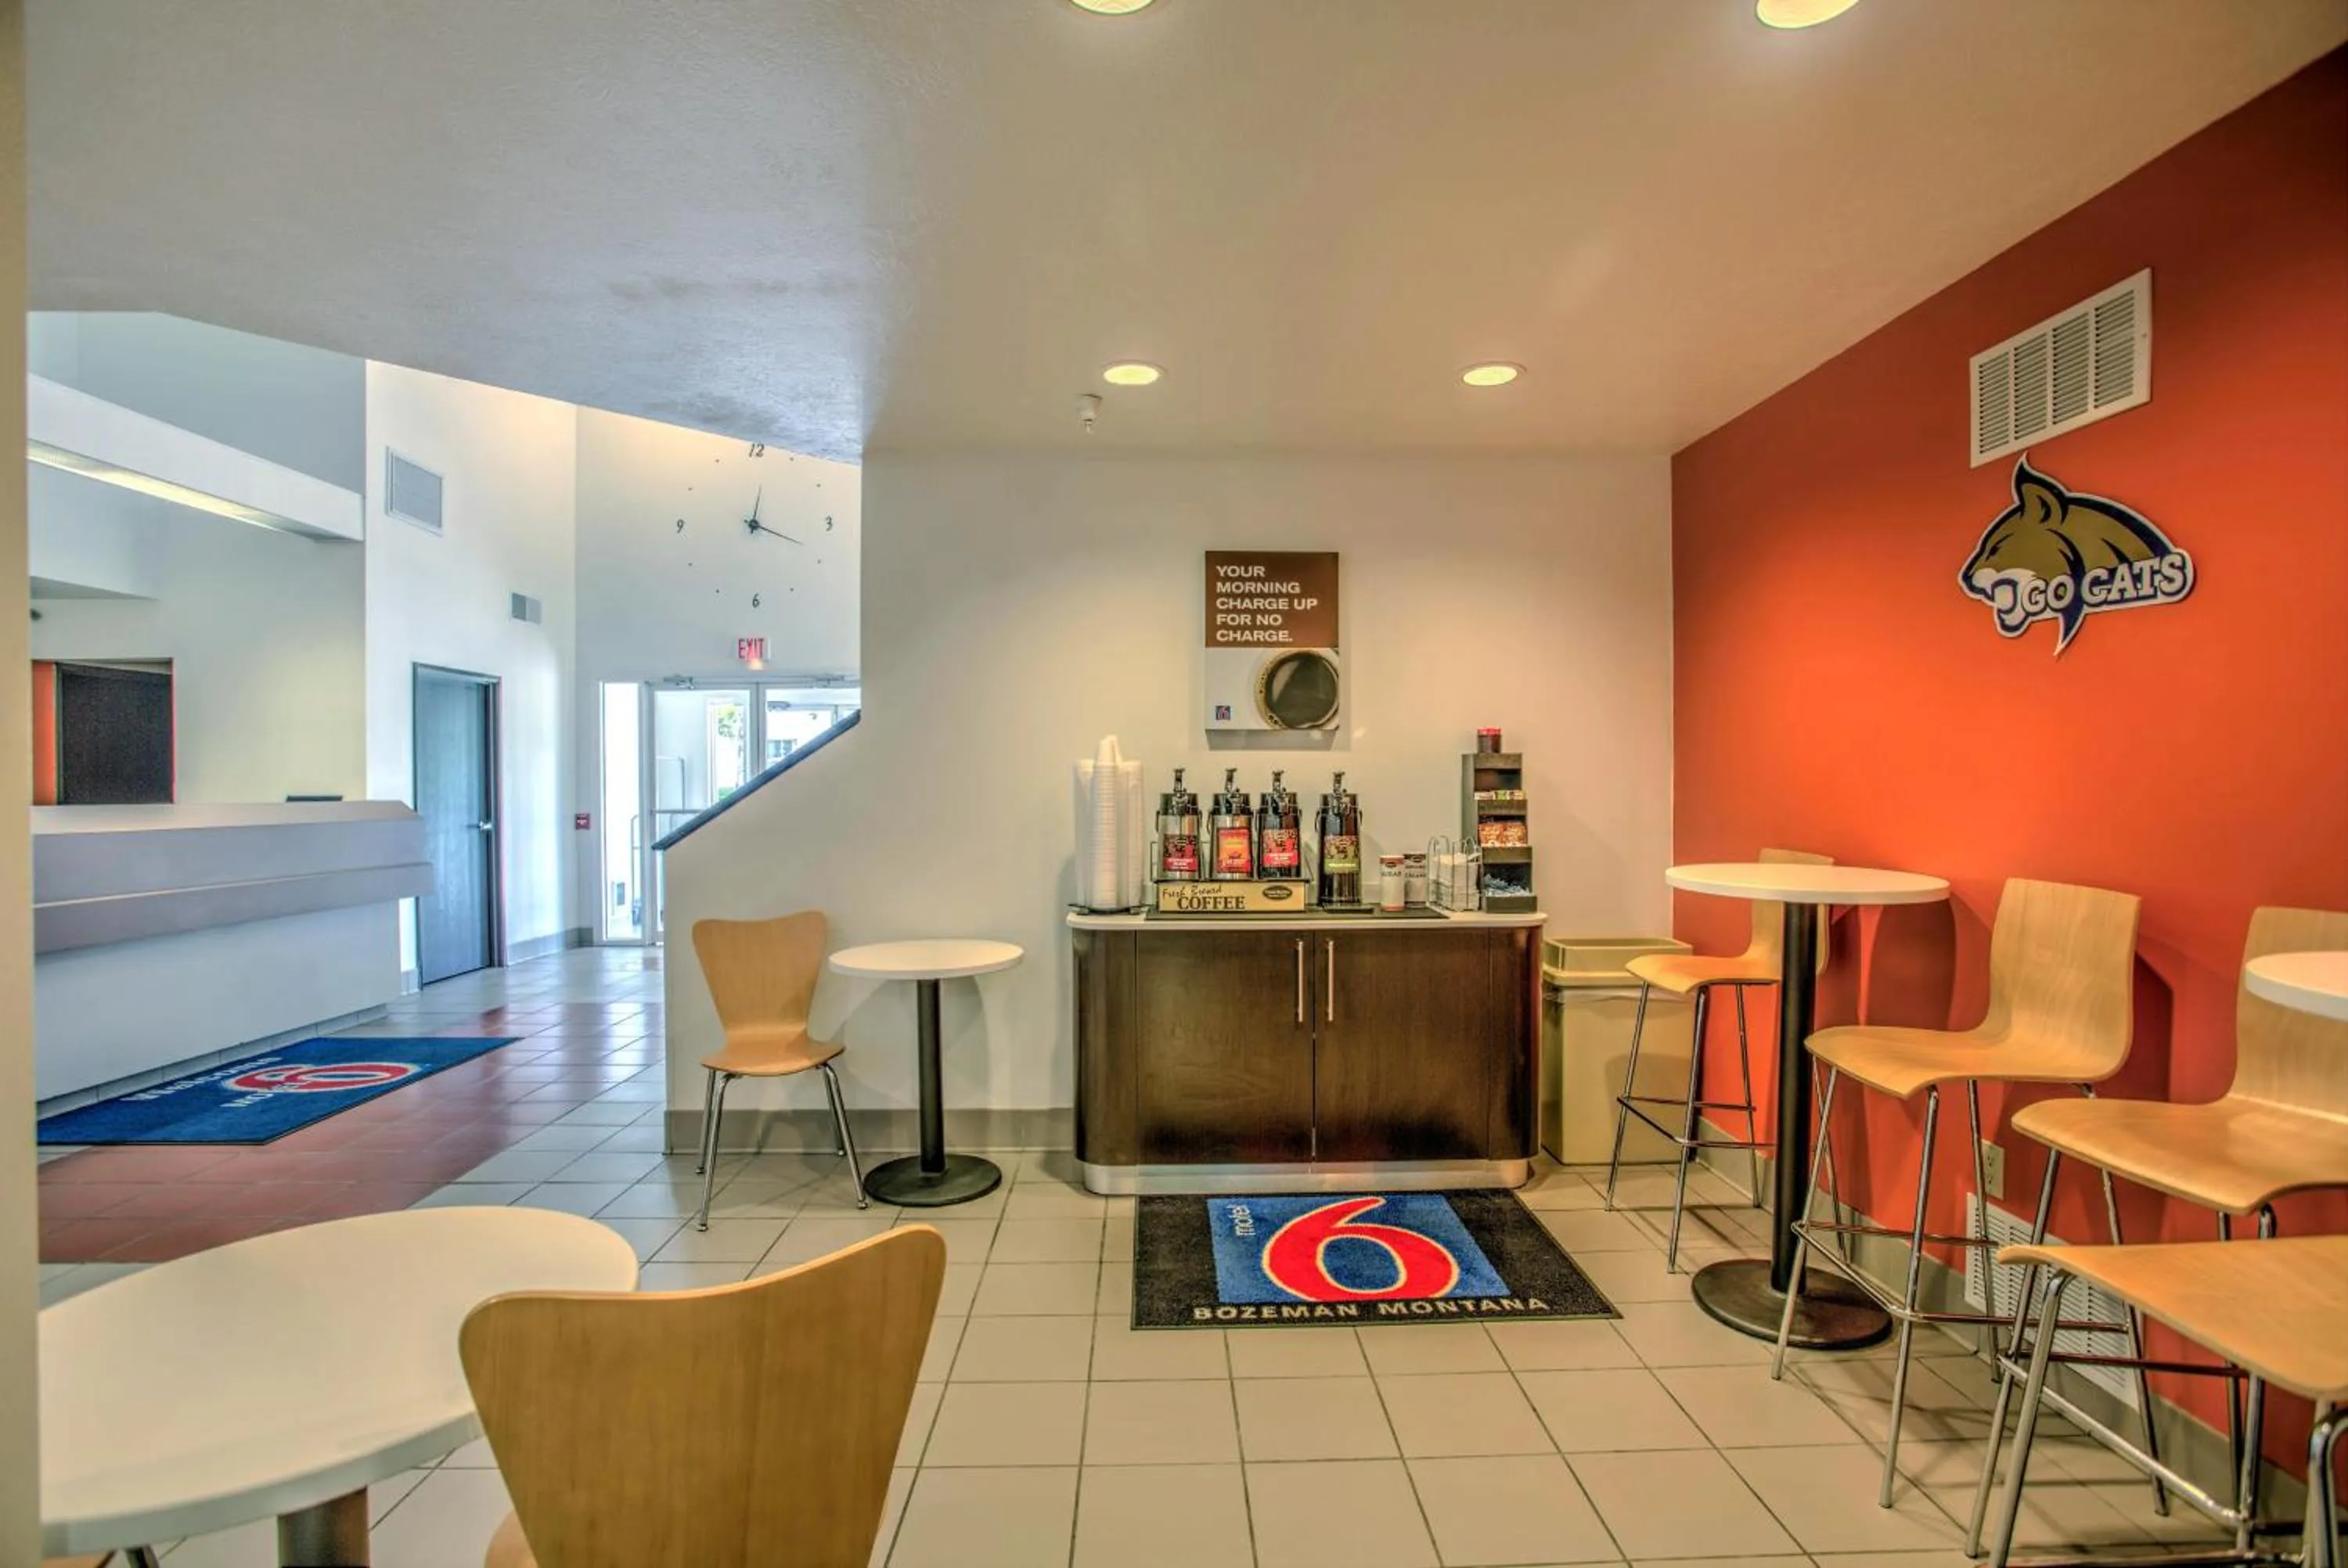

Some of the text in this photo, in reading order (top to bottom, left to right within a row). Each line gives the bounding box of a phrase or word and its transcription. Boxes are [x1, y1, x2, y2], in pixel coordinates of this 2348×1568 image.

[748, 443, 765, 458] 12
[676, 519, 685, 534] 9
[825, 515, 833, 532] 3
[1216, 565, 1266, 577] YOUR
[1216, 582, 1301, 594] MORNING
[2022, 553, 2184, 613] GO CATS
[751, 593, 760, 608] 6
[1216, 598, 1318, 610] CHARGE UP
[1216, 614, 1282, 626] FOR NO
[1216, 630, 1293, 642] CHARGE.
[738, 638, 764, 659] EXIT
[1177, 896, 1245, 910] COFFEE
[1262, 1196, 1460, 1302] 6
[1193, 1297, 1550, 1320] BOZEMAN MONTANA
